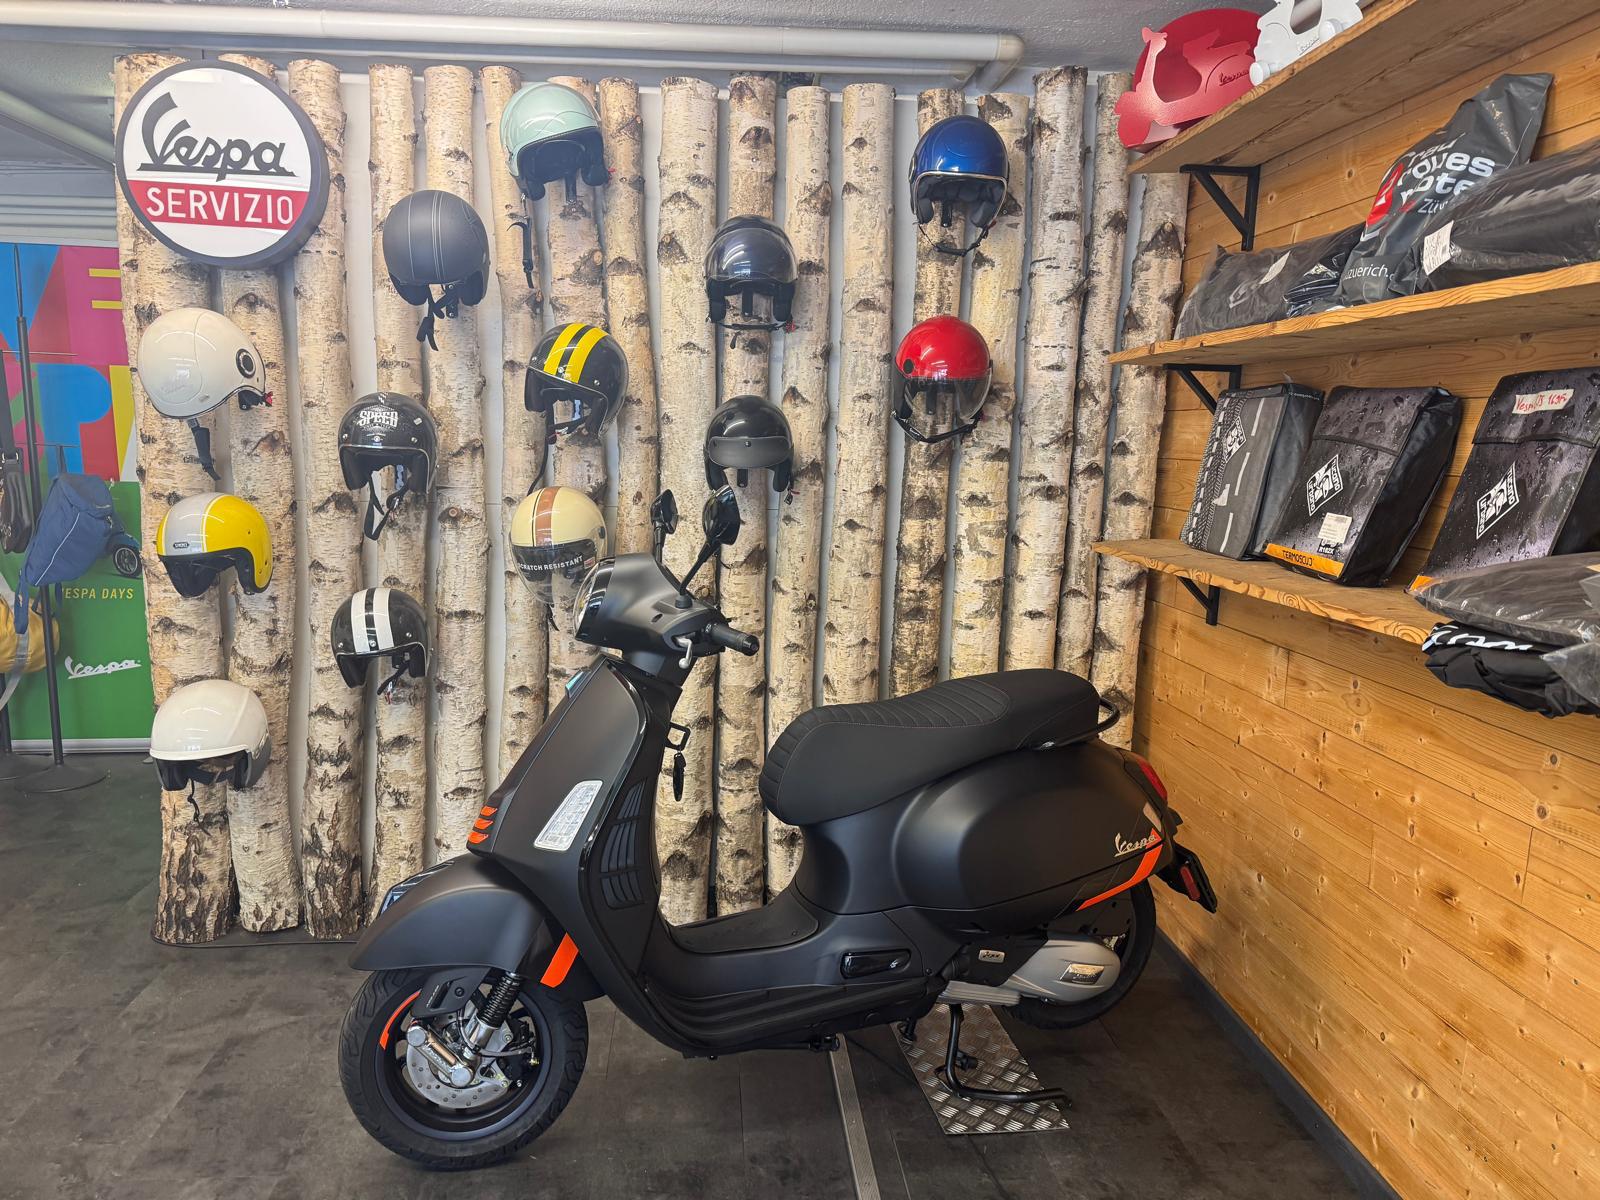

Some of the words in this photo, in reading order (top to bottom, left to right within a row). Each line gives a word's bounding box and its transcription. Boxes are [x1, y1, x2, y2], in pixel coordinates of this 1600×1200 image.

[137, 91, 297, 182] Vespa
[1397, 152, 1495, 187] roues
[147, 187, 294, 225] SERVIZIO
[357, 410, 398, 428] SPEED
[543, 555, 583, 570] RESISTANT
[62, 587, 96, 599] ESPA
[102, 587, 134, 599] DAYS
[64, 655, 142, 680] Vespa
[1113, 832, 1156, 858] Vespa
